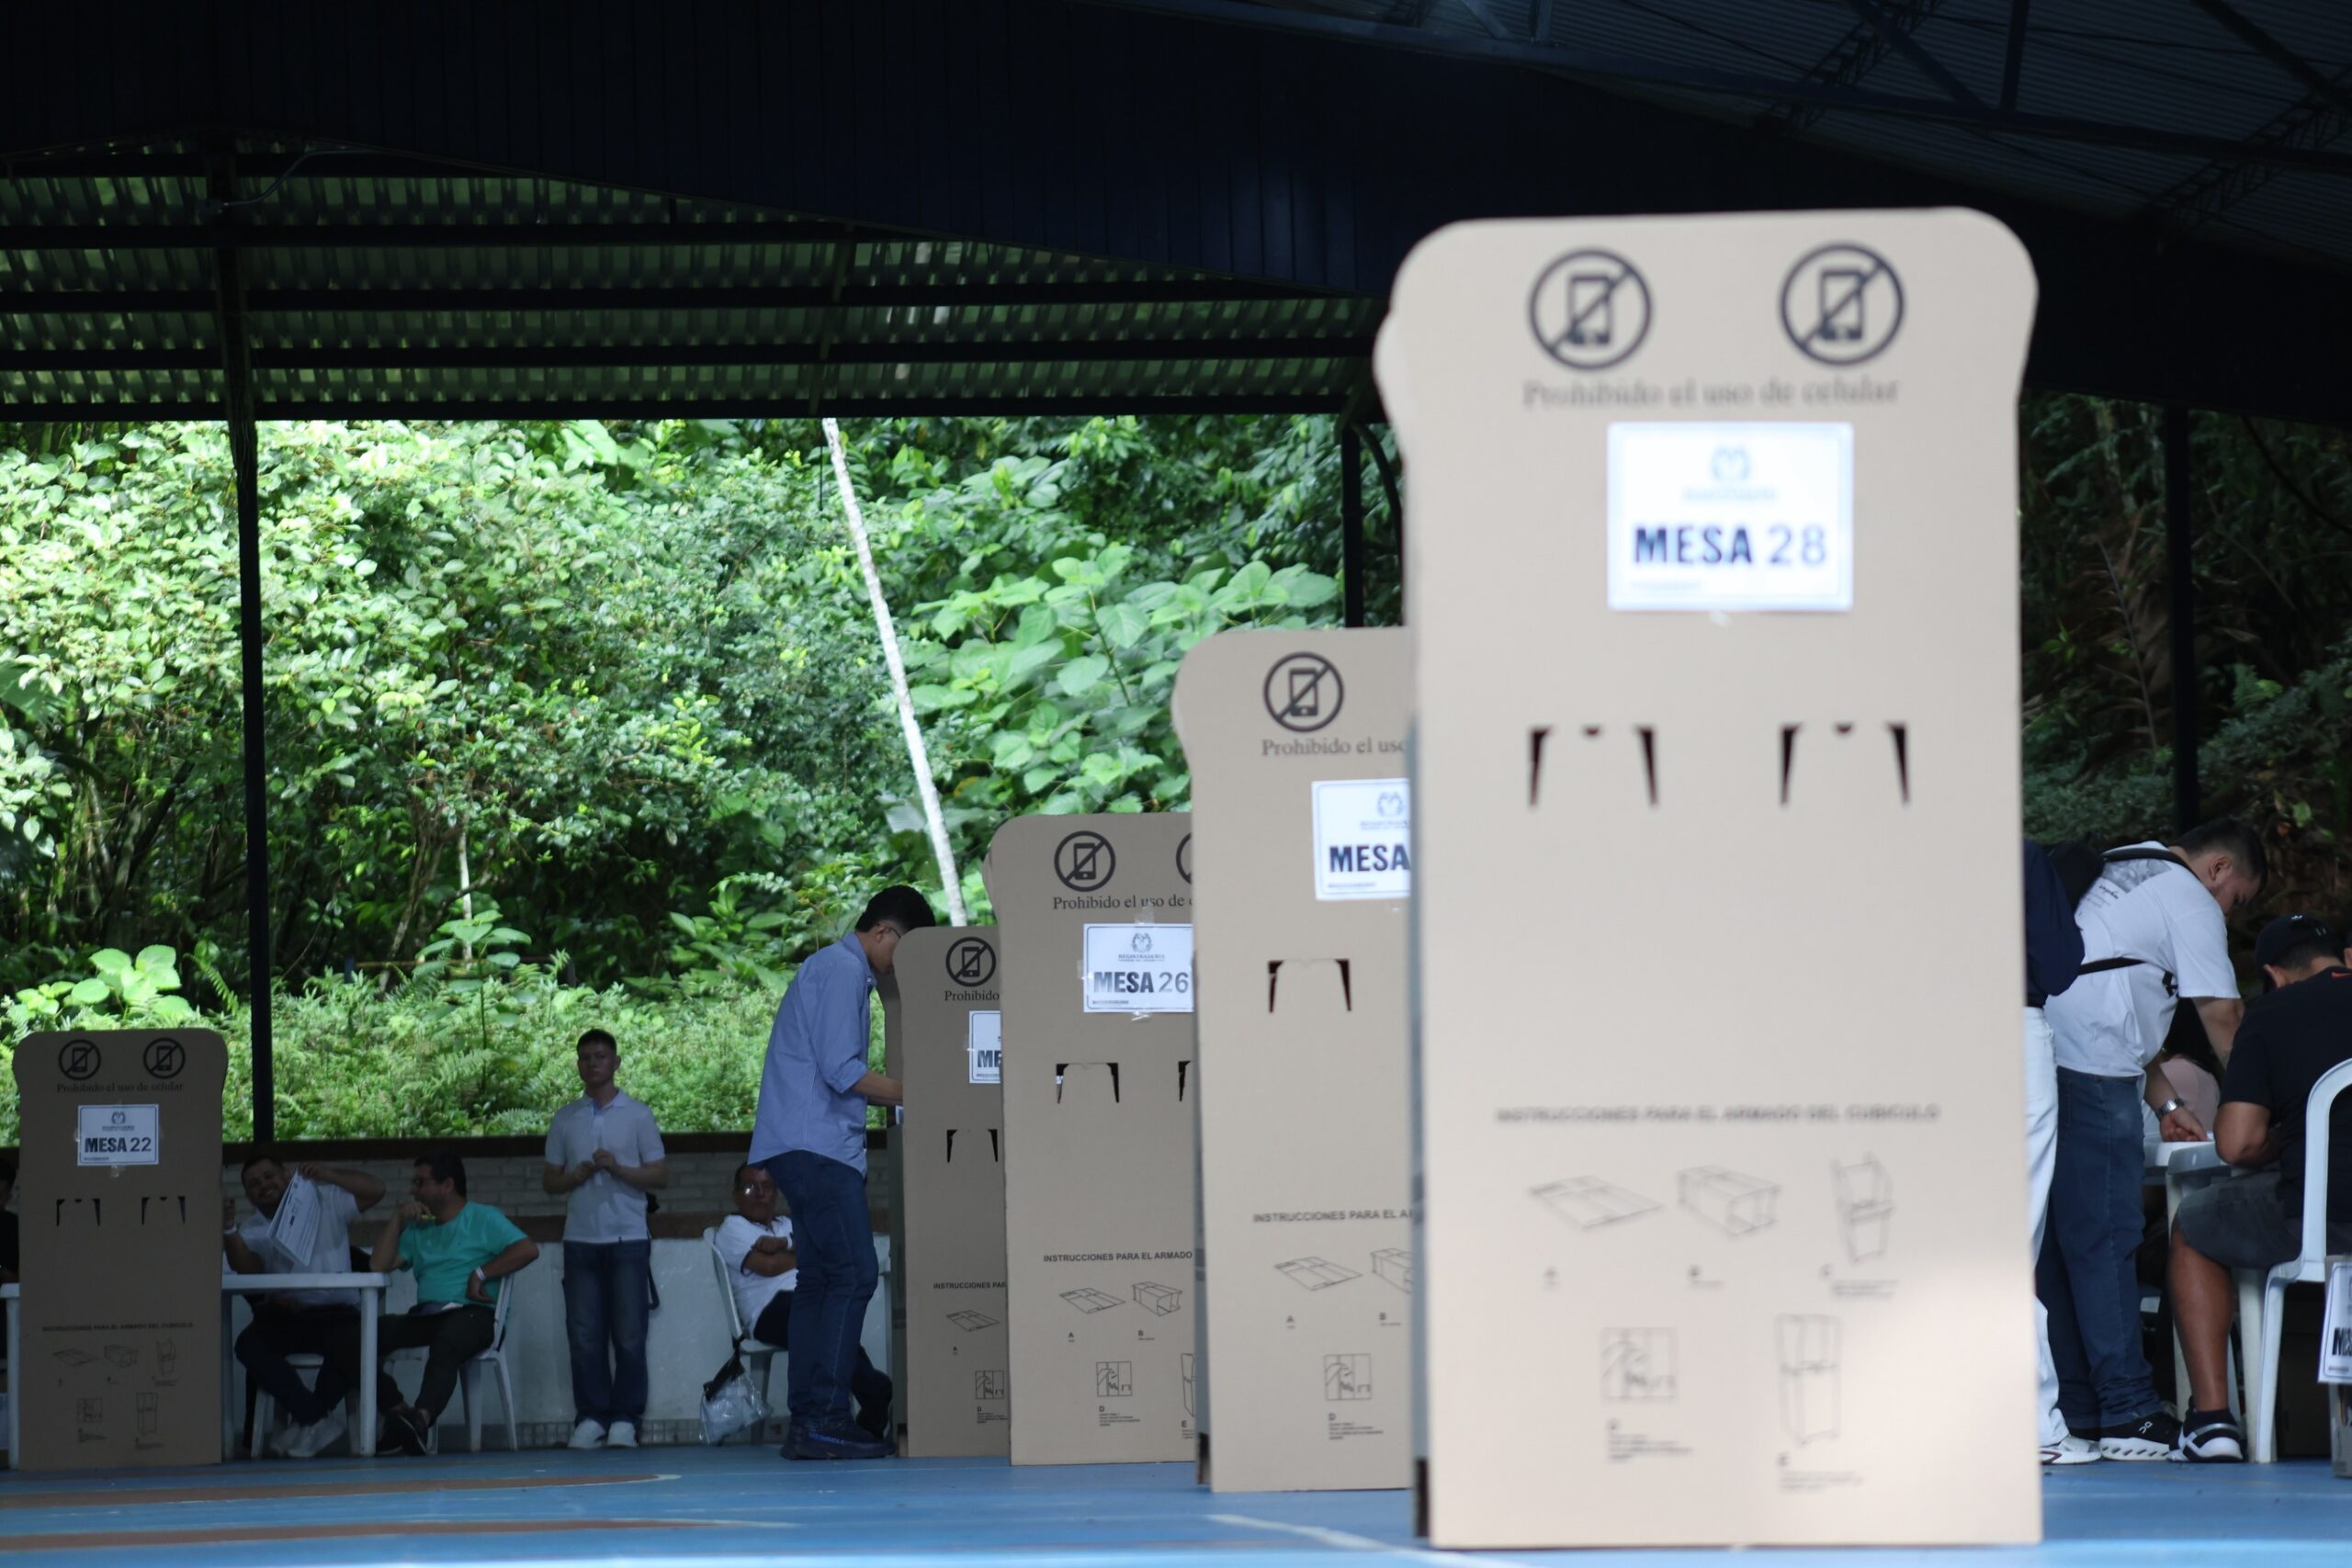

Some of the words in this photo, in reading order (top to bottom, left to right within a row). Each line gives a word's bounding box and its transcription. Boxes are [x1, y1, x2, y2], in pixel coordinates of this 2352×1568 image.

[1522, 378, 1664, 408] Prohibido
[1669, 378, 1696, 405] el
[1702, 385, 1748, 405] uso
[1758, 378, 1795, 404] de
[1802, 376, 1900, 404] celular
[1634, 525, 1753, 565] MESA
[1768, 525, 1827, 566] 28
[1261, 738, 1351, 756] Prohibido
[1356, 737, 1373, 753] el
[1329, 844, 1411, 873] MESA
[1053, 896, 1121, 909] Prohibido
[1125, 895, 1136, 908] el
[1140, 897, 1165, 908] uso
[1168, 894, 1185, 907] de
[1093, 972, 1154, 993] MESA
[1159, 972, 1189, 993] 26
[944, 990, 1001, 1001] Prohibido
[978, 1050, 1001, 1067] ME
[57, 1082, 104, 1093] Prohibido
[107, 1082, 115, 1092] el
[137, 1081, 150, 1092] de
[85, 1137, 128, 1153] MESA
[130, 1137, 152, 1152] 22
[1253, 1211, 1346, 1223] INSTRUCCIONES
[1350, 1210, 1380, 1220] PARA
[1384, 1209, 1396, 1219] EL
[1044, 1253, 1114, 1263] INSTRUCCIONES
[1116, 1252, 1140, 1260] PARA
[1142, 1252, 1153, 1260] EL
[1154, 1251, 1193, 1259] ARMADO
[933, 1281, 990, 1290] INSTRUCCIONES
